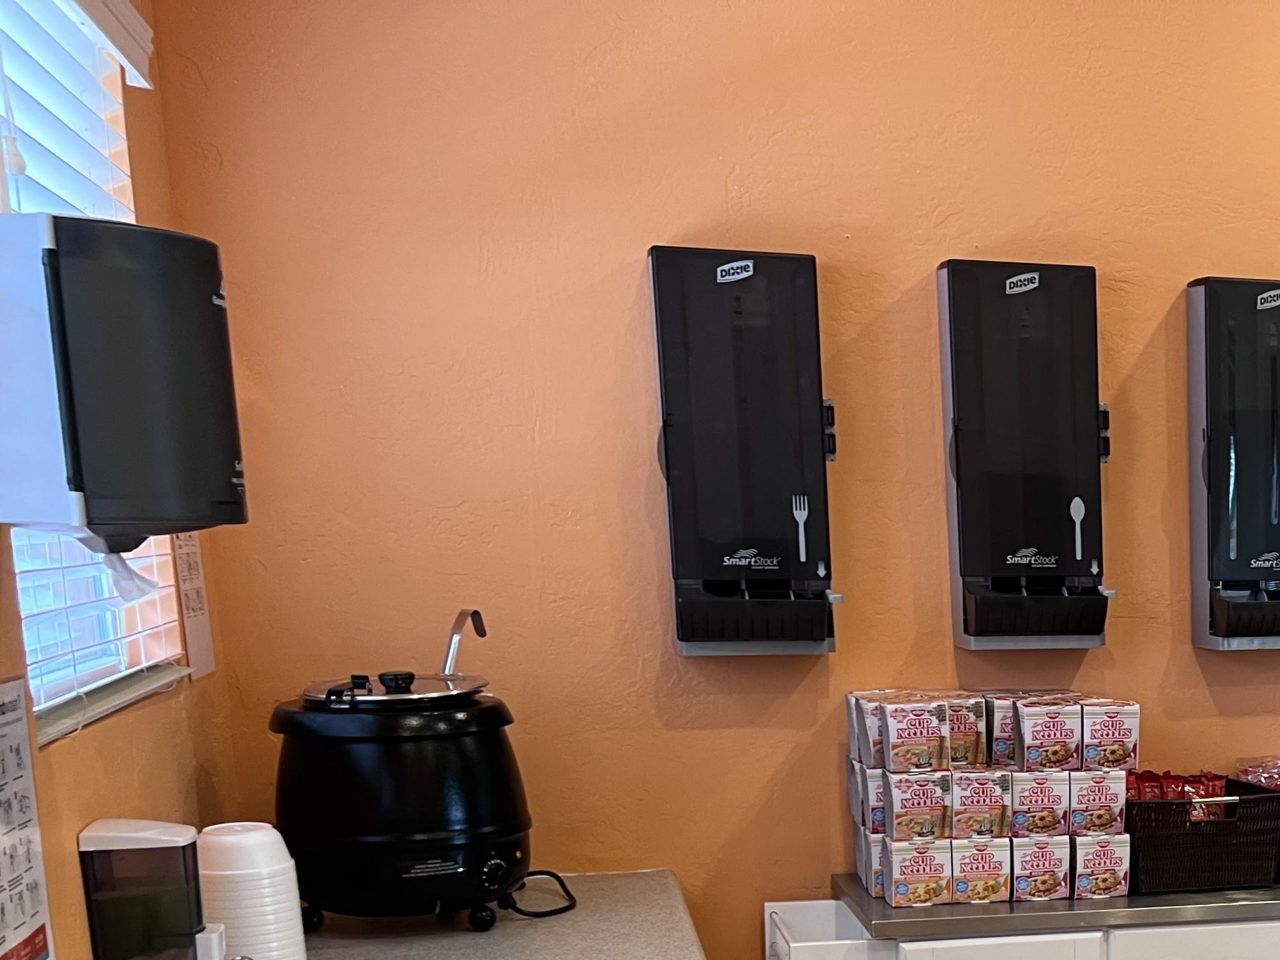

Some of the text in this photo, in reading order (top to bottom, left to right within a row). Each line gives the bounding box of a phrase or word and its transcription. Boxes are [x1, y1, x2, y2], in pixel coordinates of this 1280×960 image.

[723, 556, 779, 566] SmartStock
[1005, 555, 1056, 564] SmartStock
[906, 718, 932, 729] CUP
[1042, 720, 1066, 731] CUP
[1100, 719, 1124, 730] CUP
[897, 726, 941, 739] NOODLES
[1032, 728, 1074, 741] NOODLES
[1090, 728, 1132, 740] NOODLES
[911, 788, 936, 799] CUP
[970, 787, 995, 798] CUP
[1029, 786, 1053, 797] CUP
[1087, 785, 1111, 795] CUP
[901, 797, 945, 809] NOODLES
[960, 796, 1004, 806] NOODLES
[1019, 795, 1062, 806] NOODLES
[1077, 793, 1118, 804] NOODLES
[970, 853, 994, 864] CUP
[1031, 850, 1054, 861] CUP
[1093, 849, 1115, 859] CUP
[910, 855, 935, 866] CUP
[1021, 858, 1062, 870] NOODLES
[1083, 857, 1123, 869] NOODLES
[900, 863, 944, 876] NOODLES
[960, 861, 1003, 873] NOODLES
